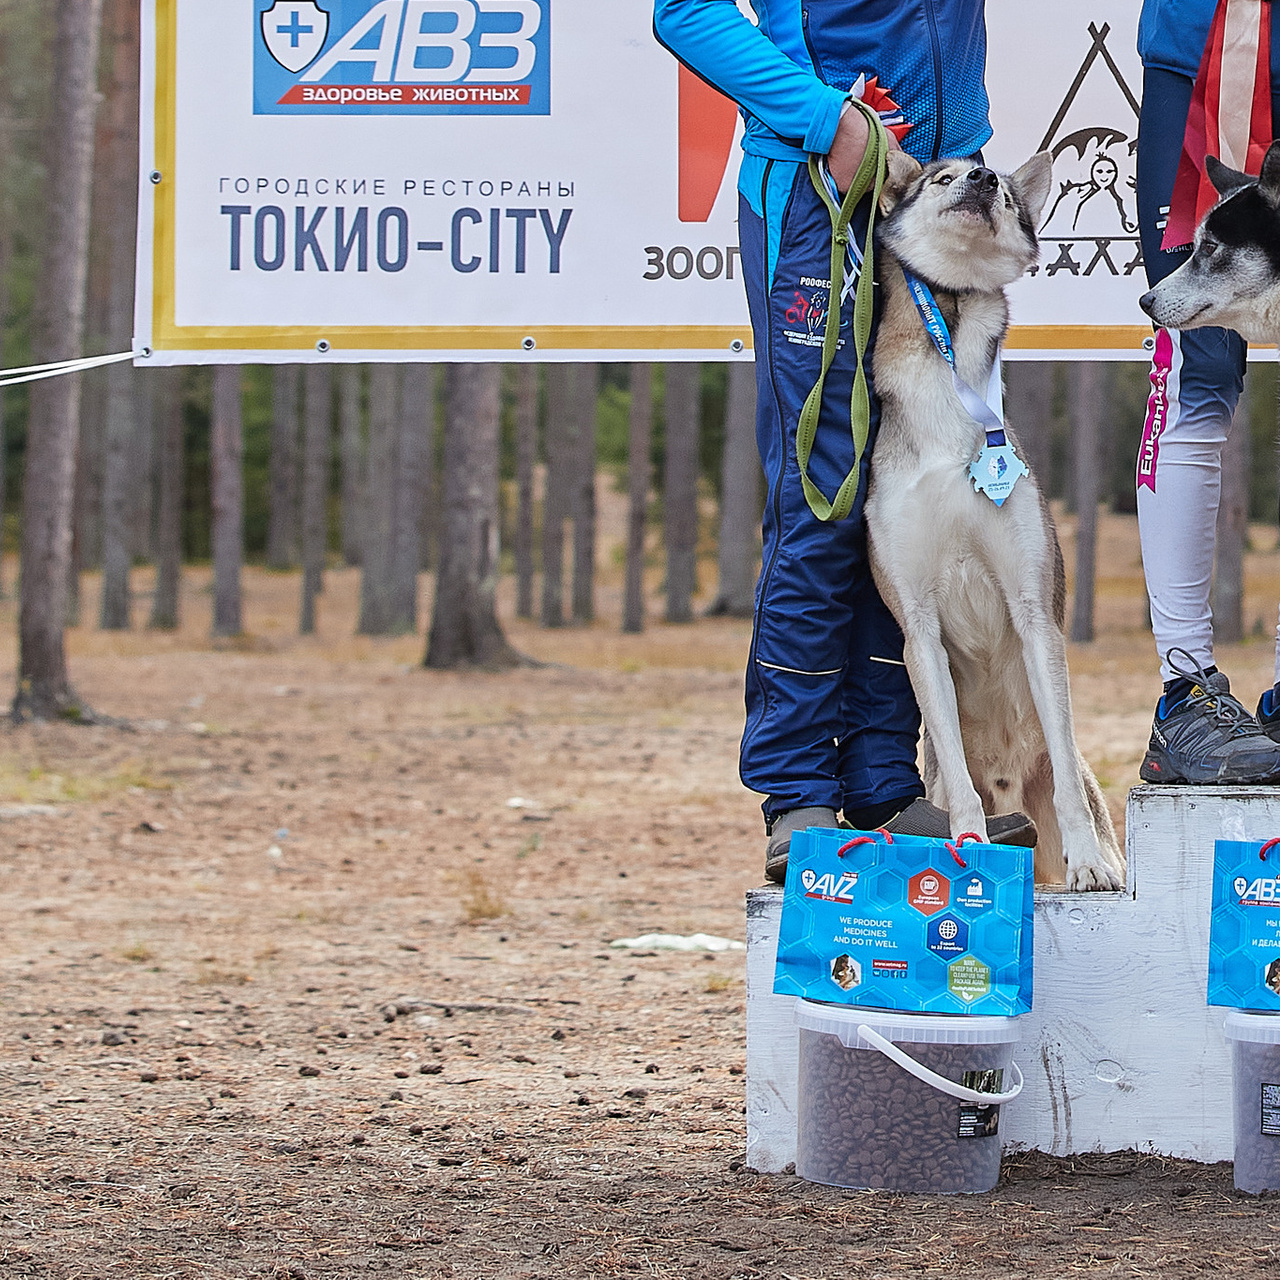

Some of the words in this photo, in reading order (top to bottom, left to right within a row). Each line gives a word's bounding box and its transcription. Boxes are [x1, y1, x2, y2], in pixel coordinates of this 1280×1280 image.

[302, 88, 402, 104] здоровье
[413, 88, 520, 101] животных
[219, 177, 386, 197] ГОРОДСКИЕ
[403, 179, 575, 198] РЕСТОРАНЫ
[220, 204, 573, 274] ТОКИО-CITY
[839, 916, 852, 925] WE
[853, 917, 893, 928] PRODUCE
[843, 927, 887, 937] MEDICINES
[833, 935, 850, 944] AND
[851, 937, 864, 946] DO
[865, 938, 873, 946] IT
[875, 939, 898, 948] WELL
